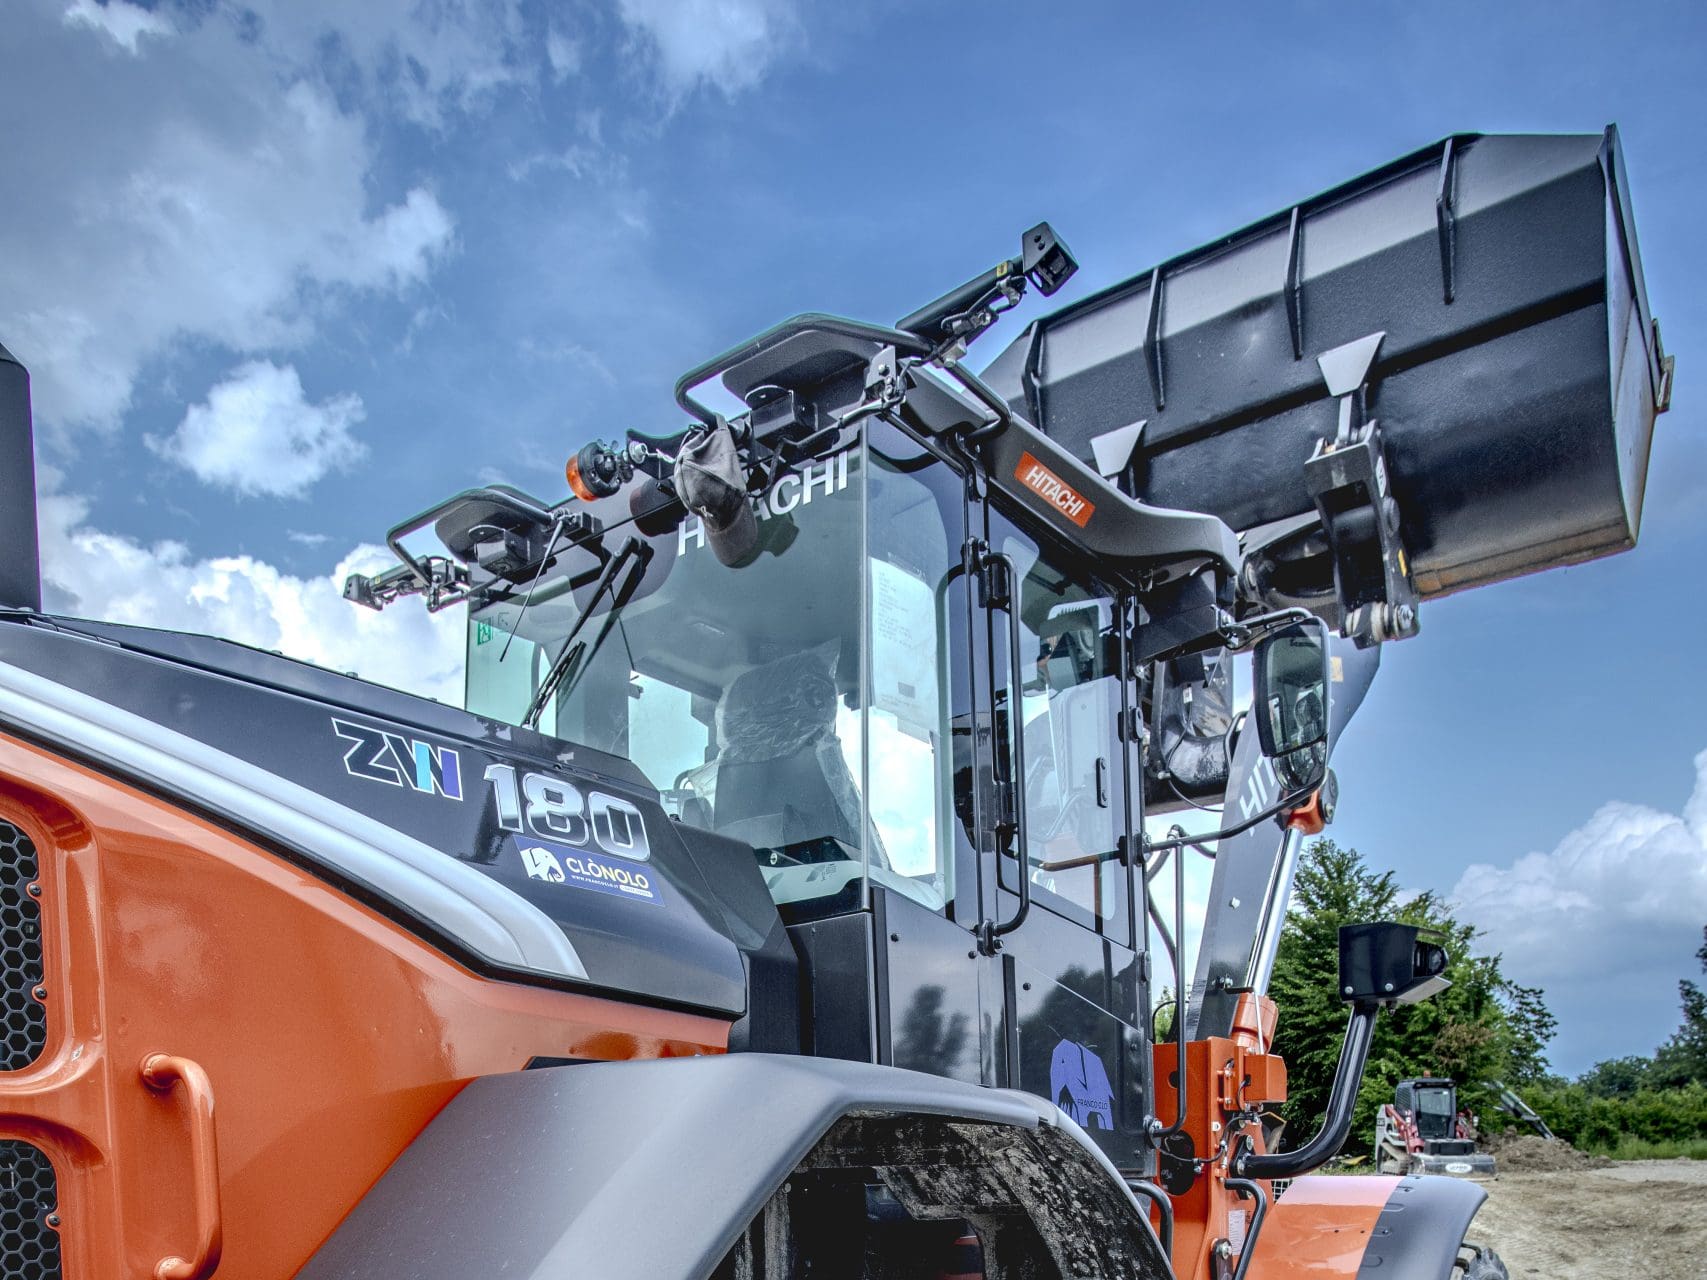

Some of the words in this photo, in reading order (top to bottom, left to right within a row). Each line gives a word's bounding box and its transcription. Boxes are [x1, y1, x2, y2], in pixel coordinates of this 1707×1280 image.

[678, 450, 848, 557] HACHI
[1025, 465, 1085, 517] HITACHI
[332, 718, 463, 801] ZW
[484, 763, 650, 862] 180
